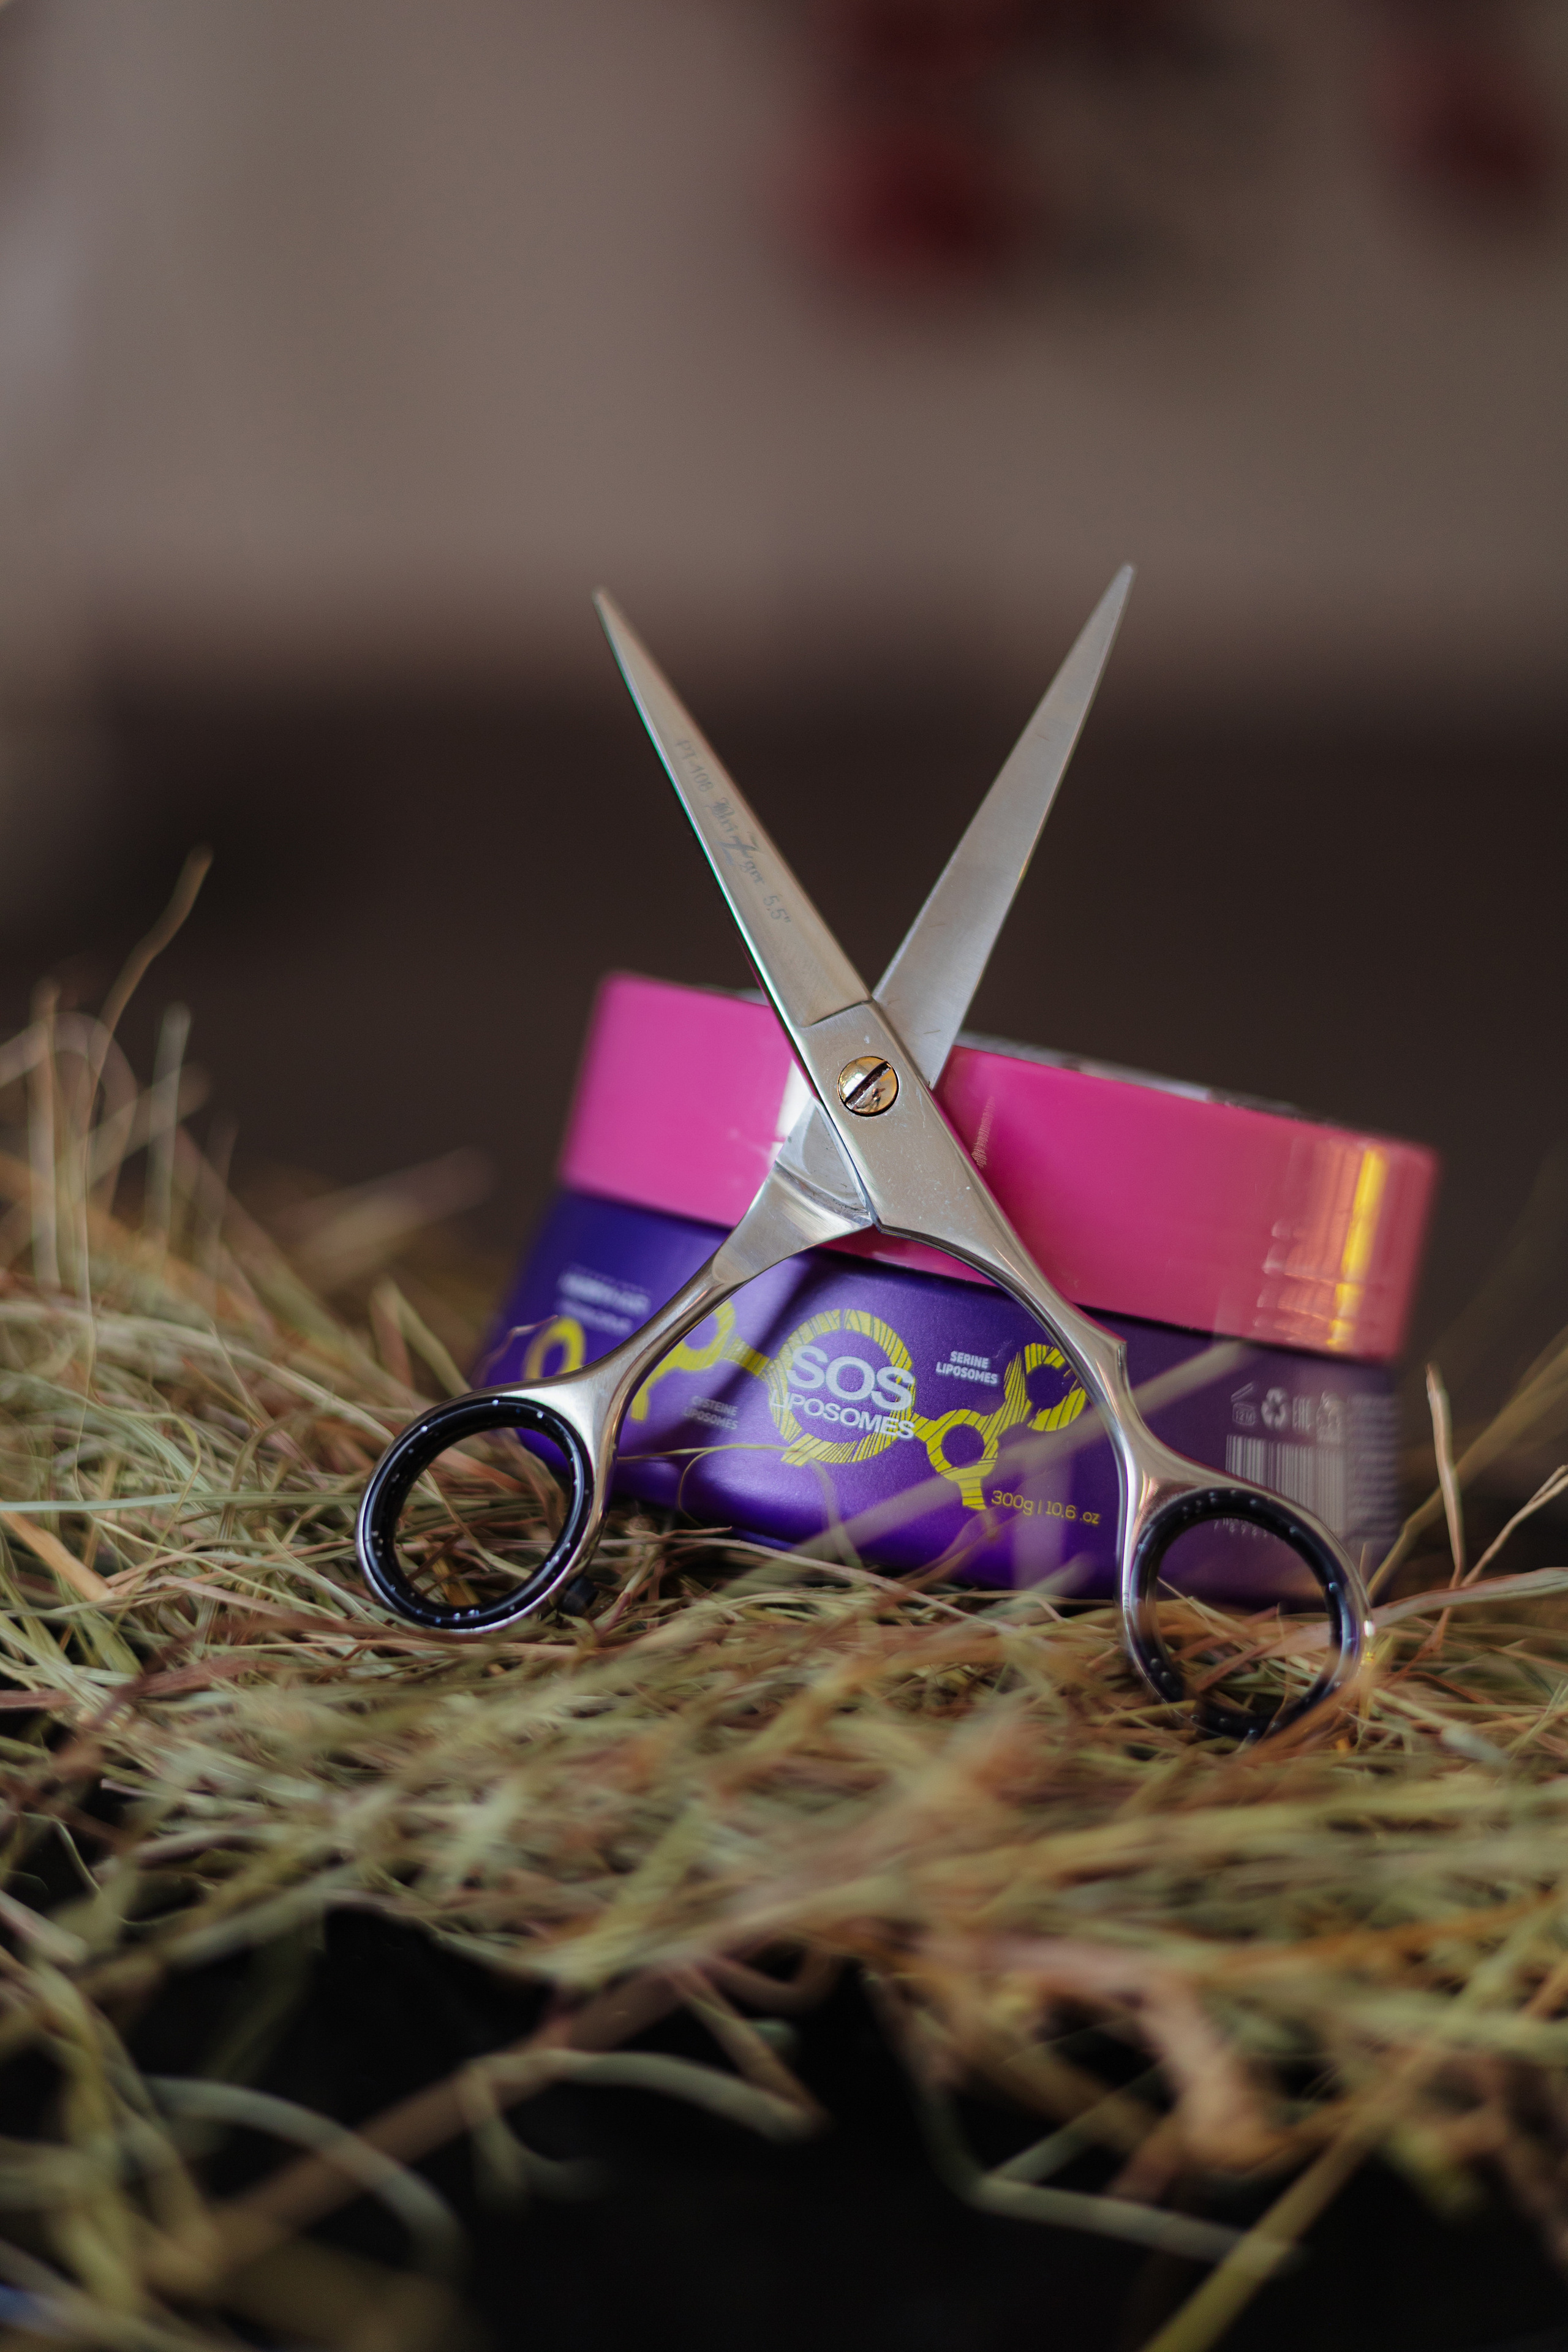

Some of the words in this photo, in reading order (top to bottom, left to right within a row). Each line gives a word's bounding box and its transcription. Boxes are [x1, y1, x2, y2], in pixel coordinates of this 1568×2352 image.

[935, 1361, 998, 1385] LIPOSOMES
[950, 1351, 990, 1370] SERINE
[786, 1345, 914, 1410] SOS
[683, 1407, 737, 1430] LIPOSOMES
[771, 1389, 915, 1439] LIPOSOMES
[991, 1490, 1035, 1516] 300g
[1046, 1501, 1076, 1520] 10.6
